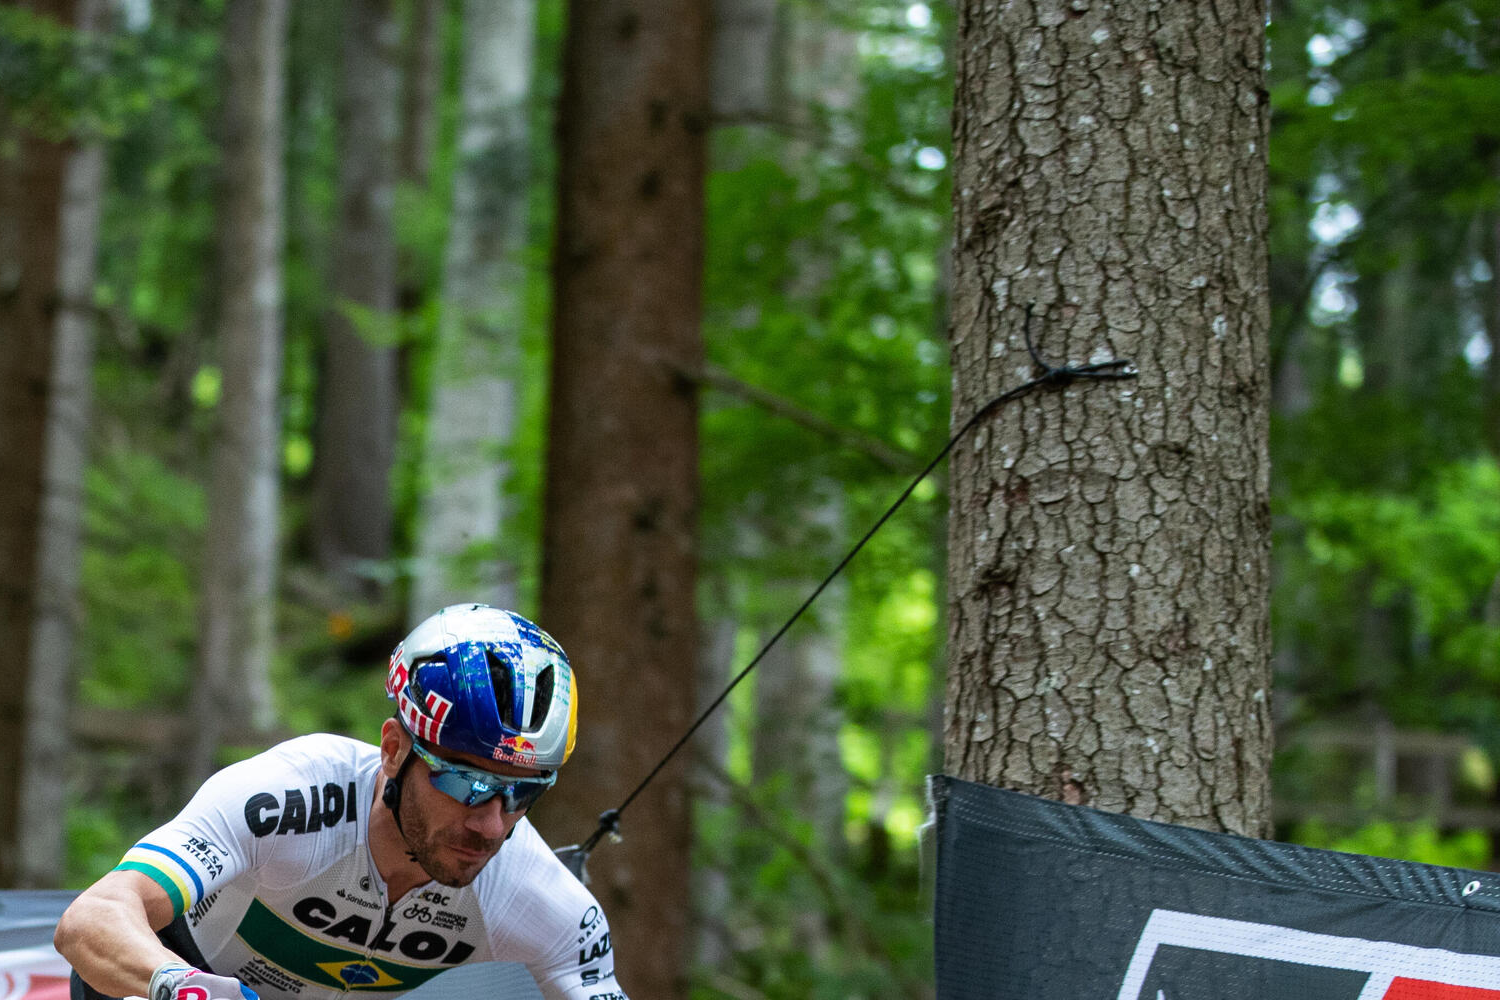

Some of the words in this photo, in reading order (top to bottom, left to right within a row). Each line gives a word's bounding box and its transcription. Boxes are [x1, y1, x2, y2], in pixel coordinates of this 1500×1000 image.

[244, 782, 357, 838] CALOI
[181, 843, 217, 880] ATLETA
[293, 896, 476, 964] CALOI
[578, 914, 604, 944] OAKL
[579, 931, 612, 966] LAZ
